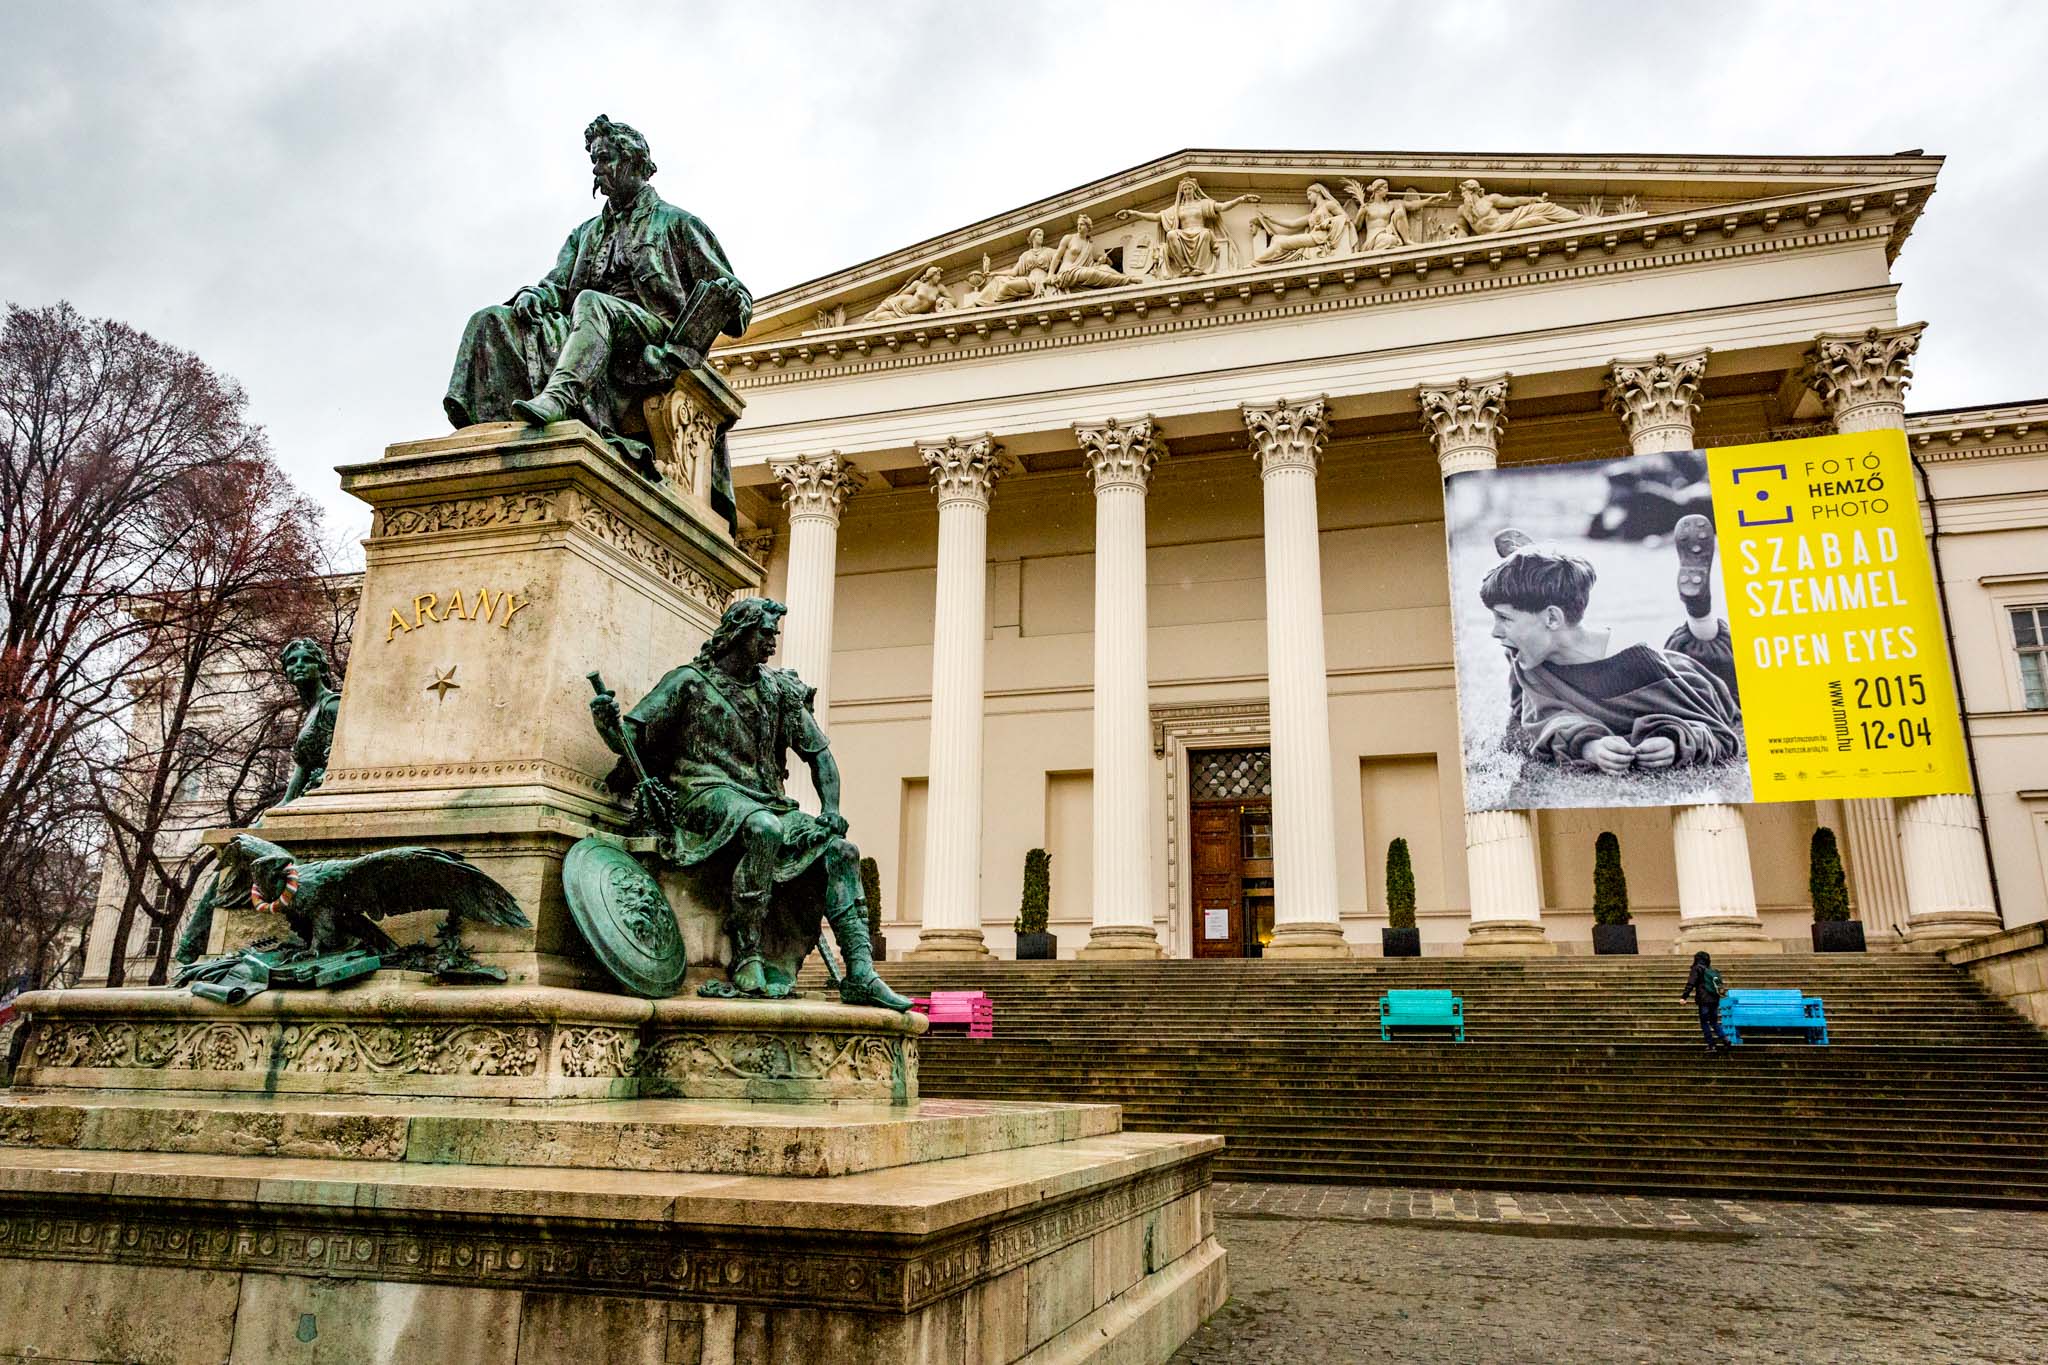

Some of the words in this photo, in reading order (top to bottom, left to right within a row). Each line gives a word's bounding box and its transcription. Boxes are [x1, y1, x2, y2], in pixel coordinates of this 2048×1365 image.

[1805, 451, 1881, 477] FOTÓ
[1808, 472, 1885, 498] HEMZŐ
[1811, 498, 1889, 520] PHOTO
[1740, 527, 1899, 576] SZABAD
[386, 587, 531, 644] ARANY
[1745, 570, 1908, 618] SZEMMEL
[1753, 633, 1831, 669] OPEN
[1843, 626, 1918, 664] EYES
[1854, 673, 1927, 709] 2015
[1828, 680, 1853, 752] www.mnm.hu
